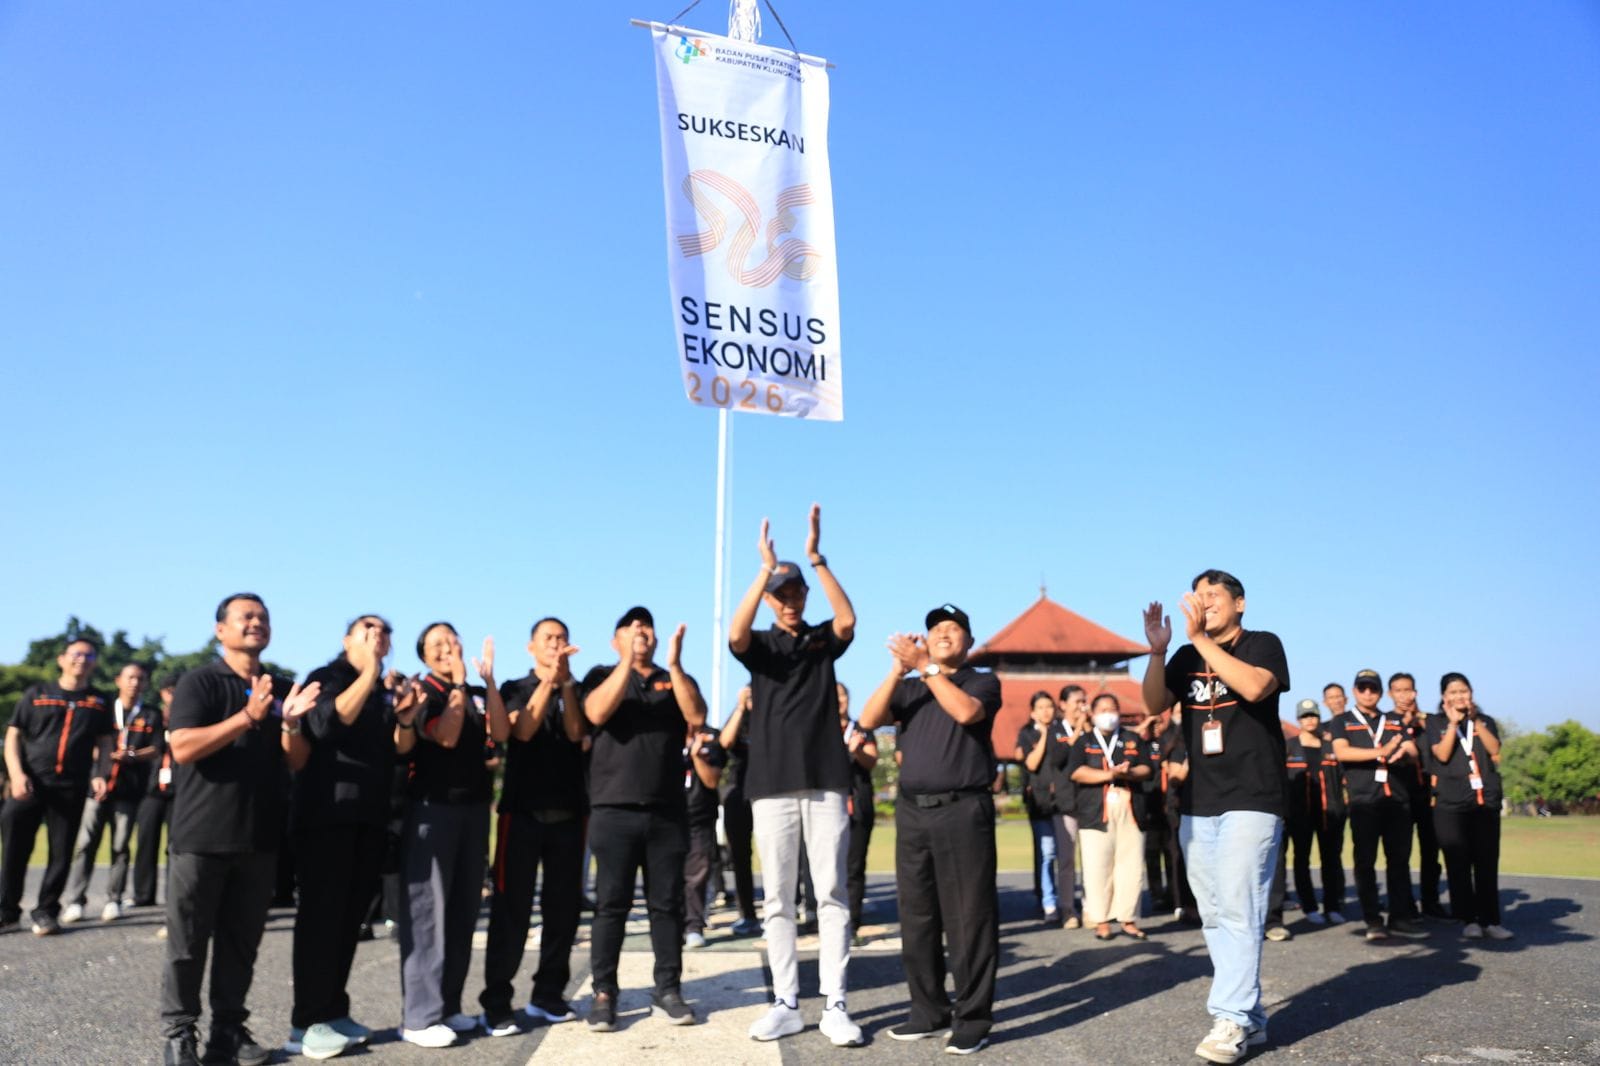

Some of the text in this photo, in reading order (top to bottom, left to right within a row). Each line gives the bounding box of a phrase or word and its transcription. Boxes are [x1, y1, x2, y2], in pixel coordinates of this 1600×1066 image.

[715, 48, 801, 75] BADAN PUSAT STATISTK
[715, 56, 761, 70] KABUPATEN
[678, 113, 804, 154] SUKSESKAN
[681, 296, 826, 344] SENSUS
[683, 333, 825, 381] EKONOMI
[687, 372, 784, 412] 2026
